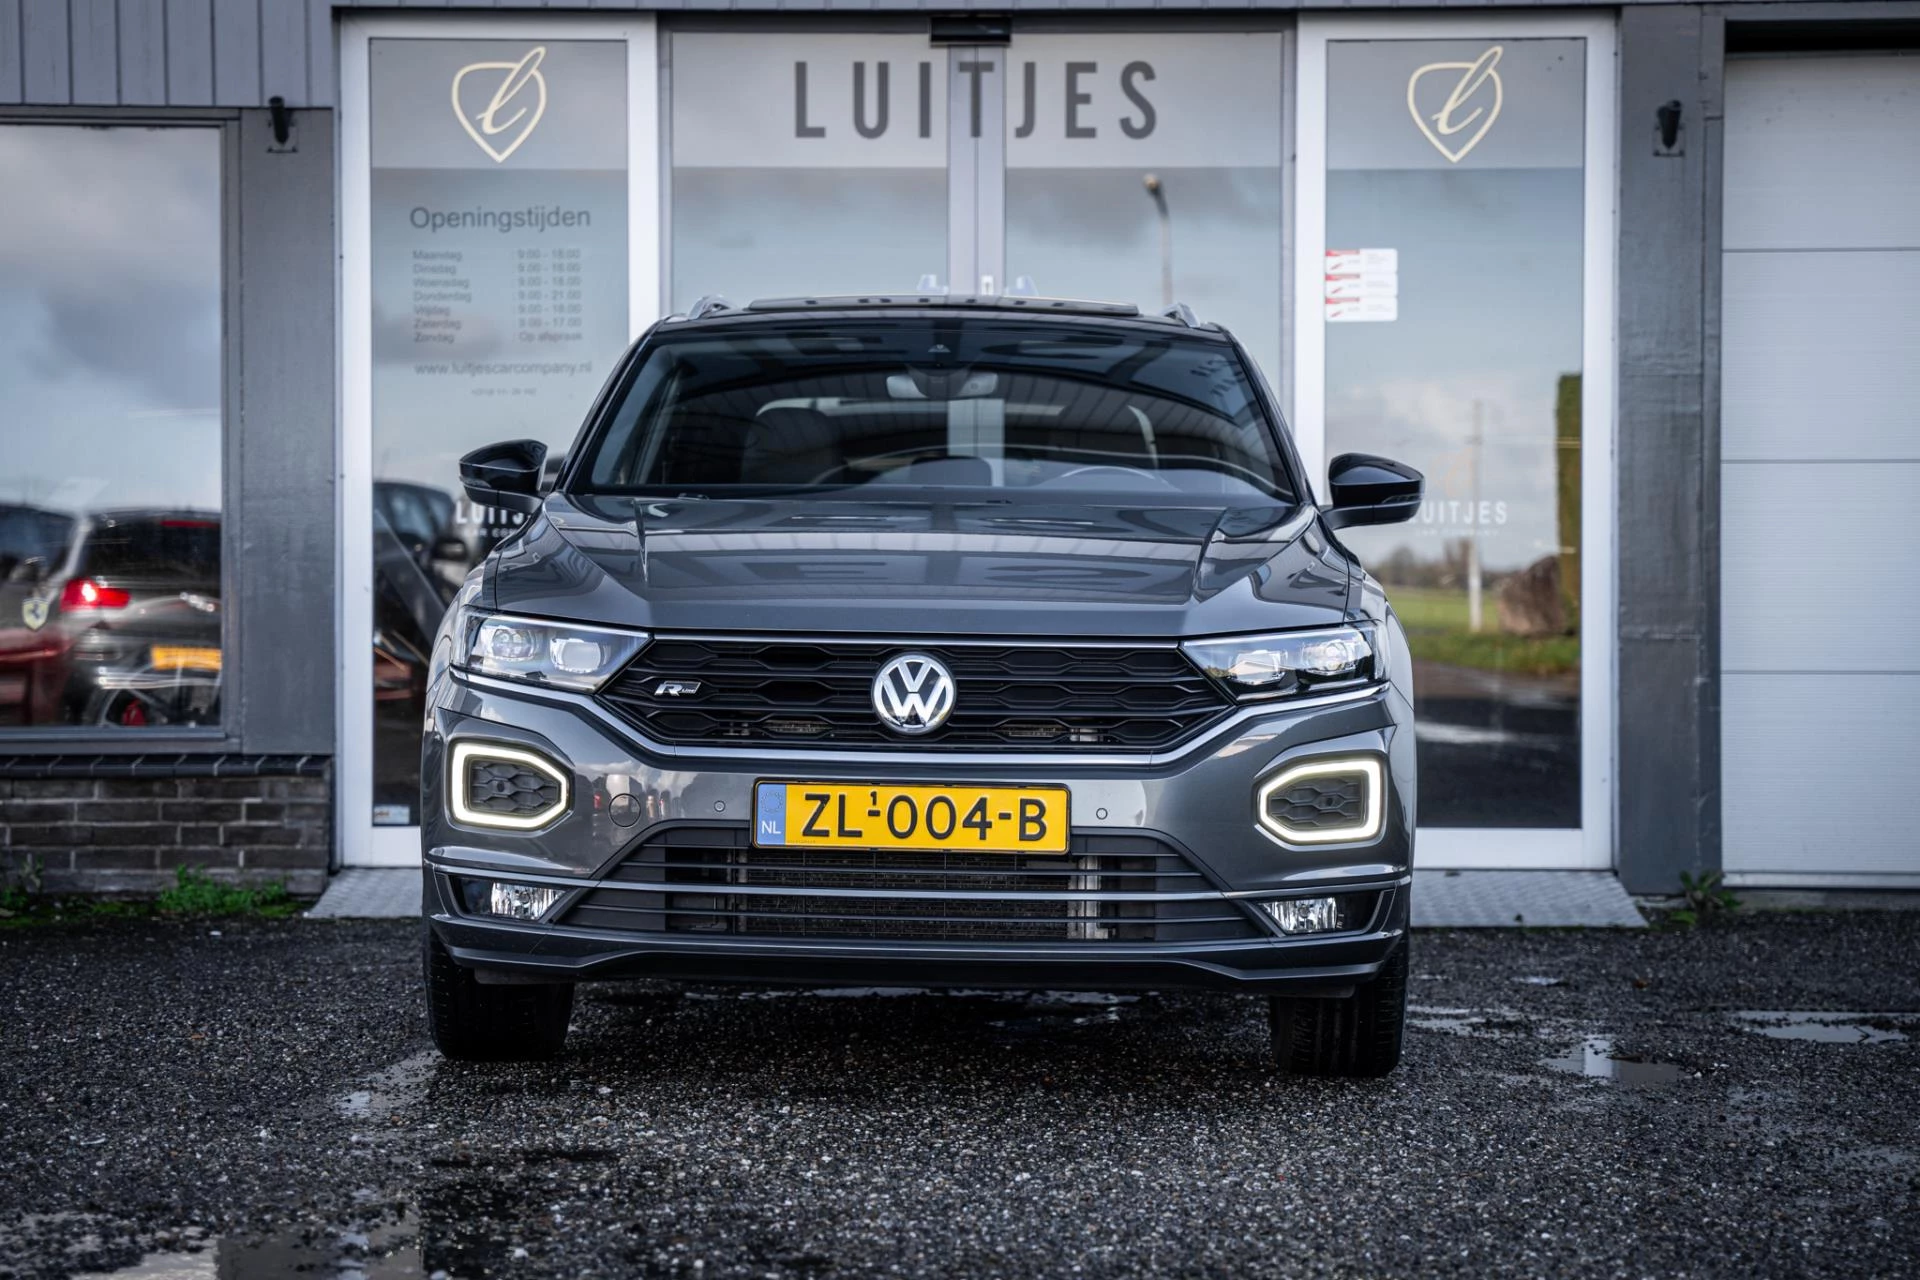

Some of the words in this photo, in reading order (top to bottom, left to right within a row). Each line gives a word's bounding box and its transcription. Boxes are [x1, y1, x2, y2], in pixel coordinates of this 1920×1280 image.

[795, 61, 1157, 139] LUITJES
[410, 206, 591, 233] Openingstijden
[878, 657, 951, 726] VW
[761, 820, 781, 834] NL
